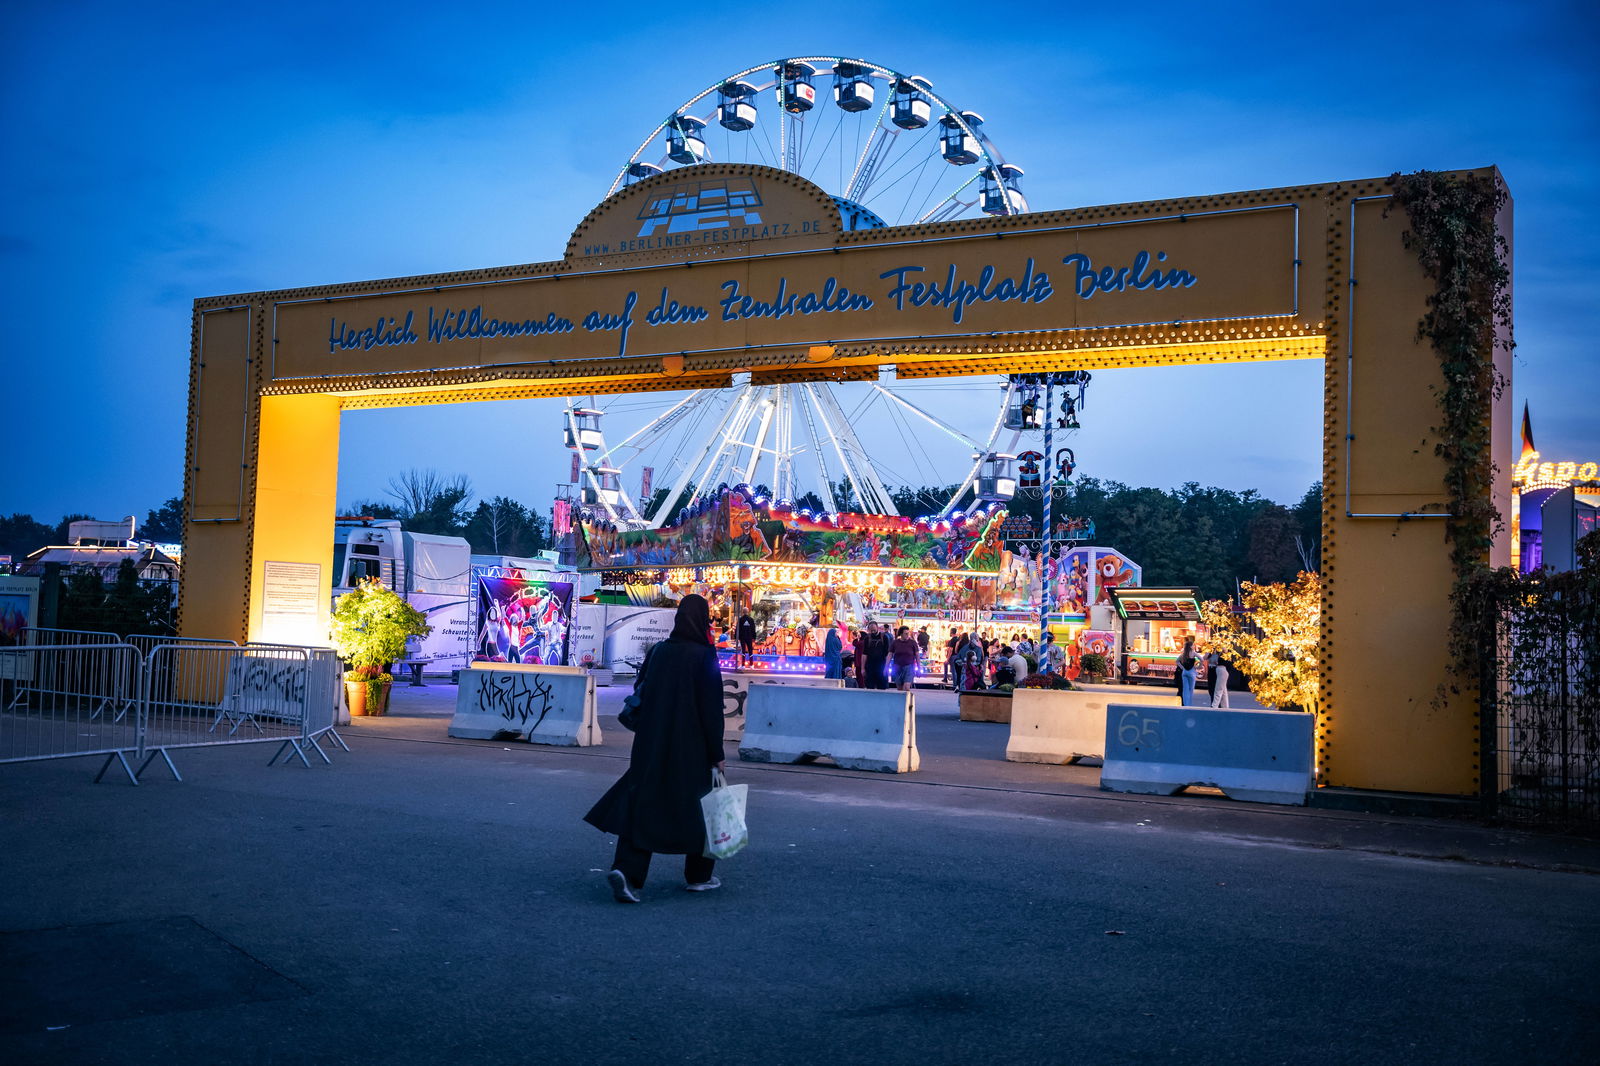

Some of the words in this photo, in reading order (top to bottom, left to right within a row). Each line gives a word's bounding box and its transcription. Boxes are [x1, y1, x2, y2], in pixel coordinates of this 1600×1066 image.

[584, 220, 821, 256] WWW.BERLINER-FESTPLATZ.DE
[328, 309, 419, 354] Herzlich
[427, 305, 575, 345] Willkommen
[581, 290, 639, 358] auf
[645, 286, 709, 327] dem
[719, 277, 874, 322] Zentralen
[879, 257, 1054, 325] Festplatz
[1062, 249, 1198, 300] Berlin
[1118, 710, 1161, 750] 65
